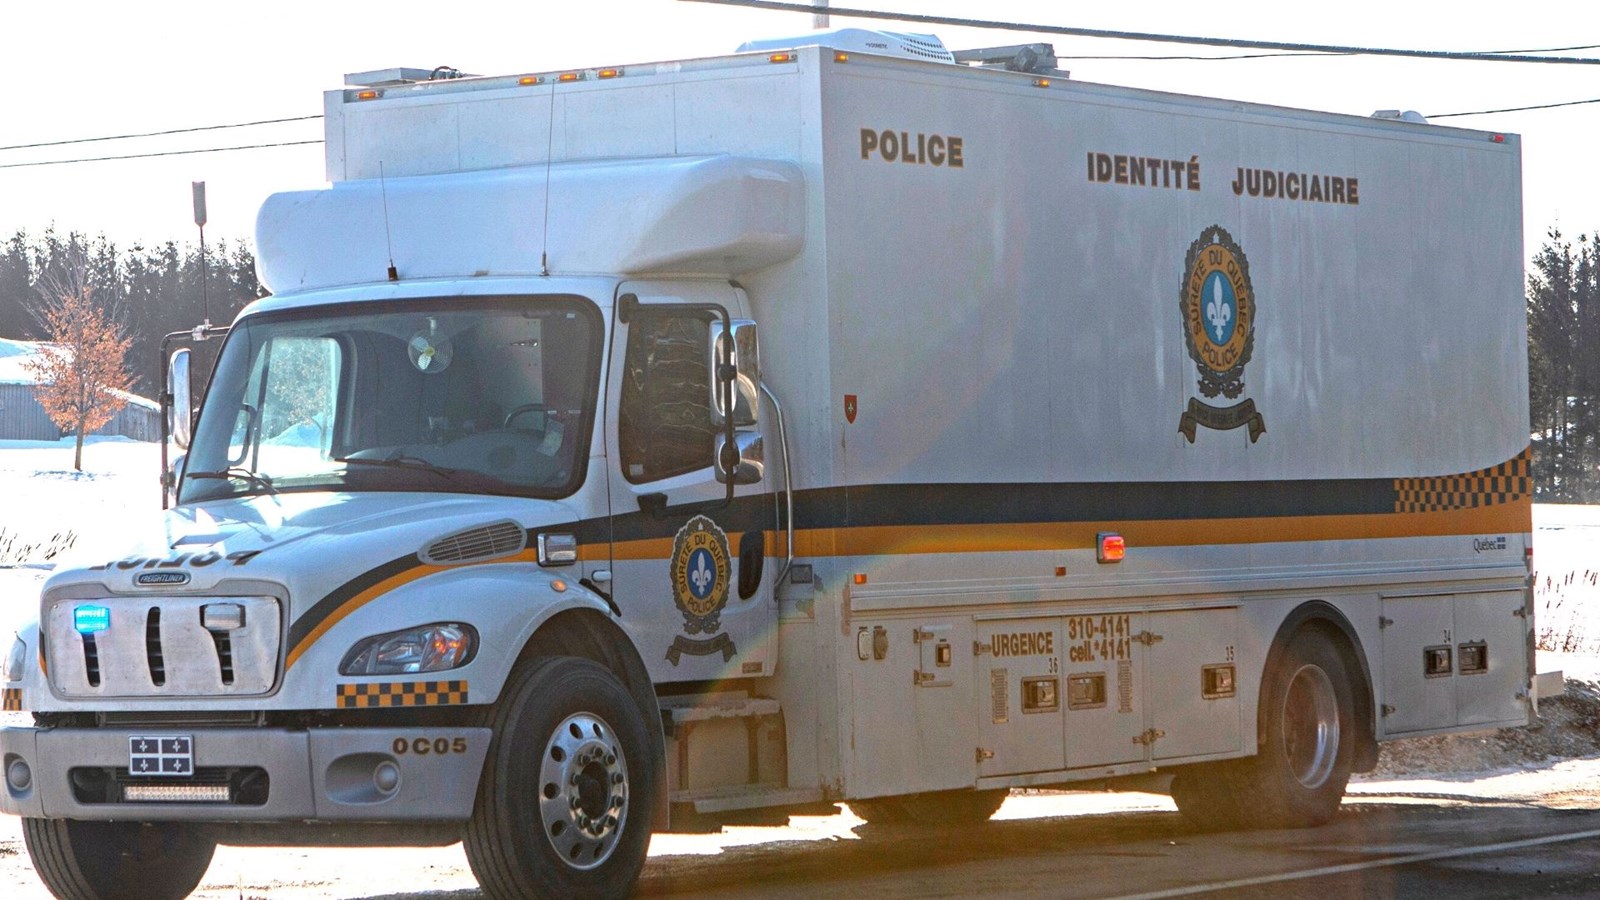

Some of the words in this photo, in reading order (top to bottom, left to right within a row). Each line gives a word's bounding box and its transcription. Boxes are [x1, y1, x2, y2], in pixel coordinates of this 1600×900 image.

[860, 128, 963, 168] POLICE
[1087, 152, 1200, 191] IDENTITÉ
[1231, 167, 1359, 205] JUDICIAIRE
[1209, 250, 1222, 265] DU
[1202, 342, 1238, 366] POLICE
[694, 534, 706, 545] DU
[140, 573, 184, 583] FREIGHTLINER
[687, 596, 716, 613] POLICE
[1068, 615, 1131, 640] 310-4141
[991, 631, 1054, 657] URGENCE
[1048, 657, 1058, 674] 36
